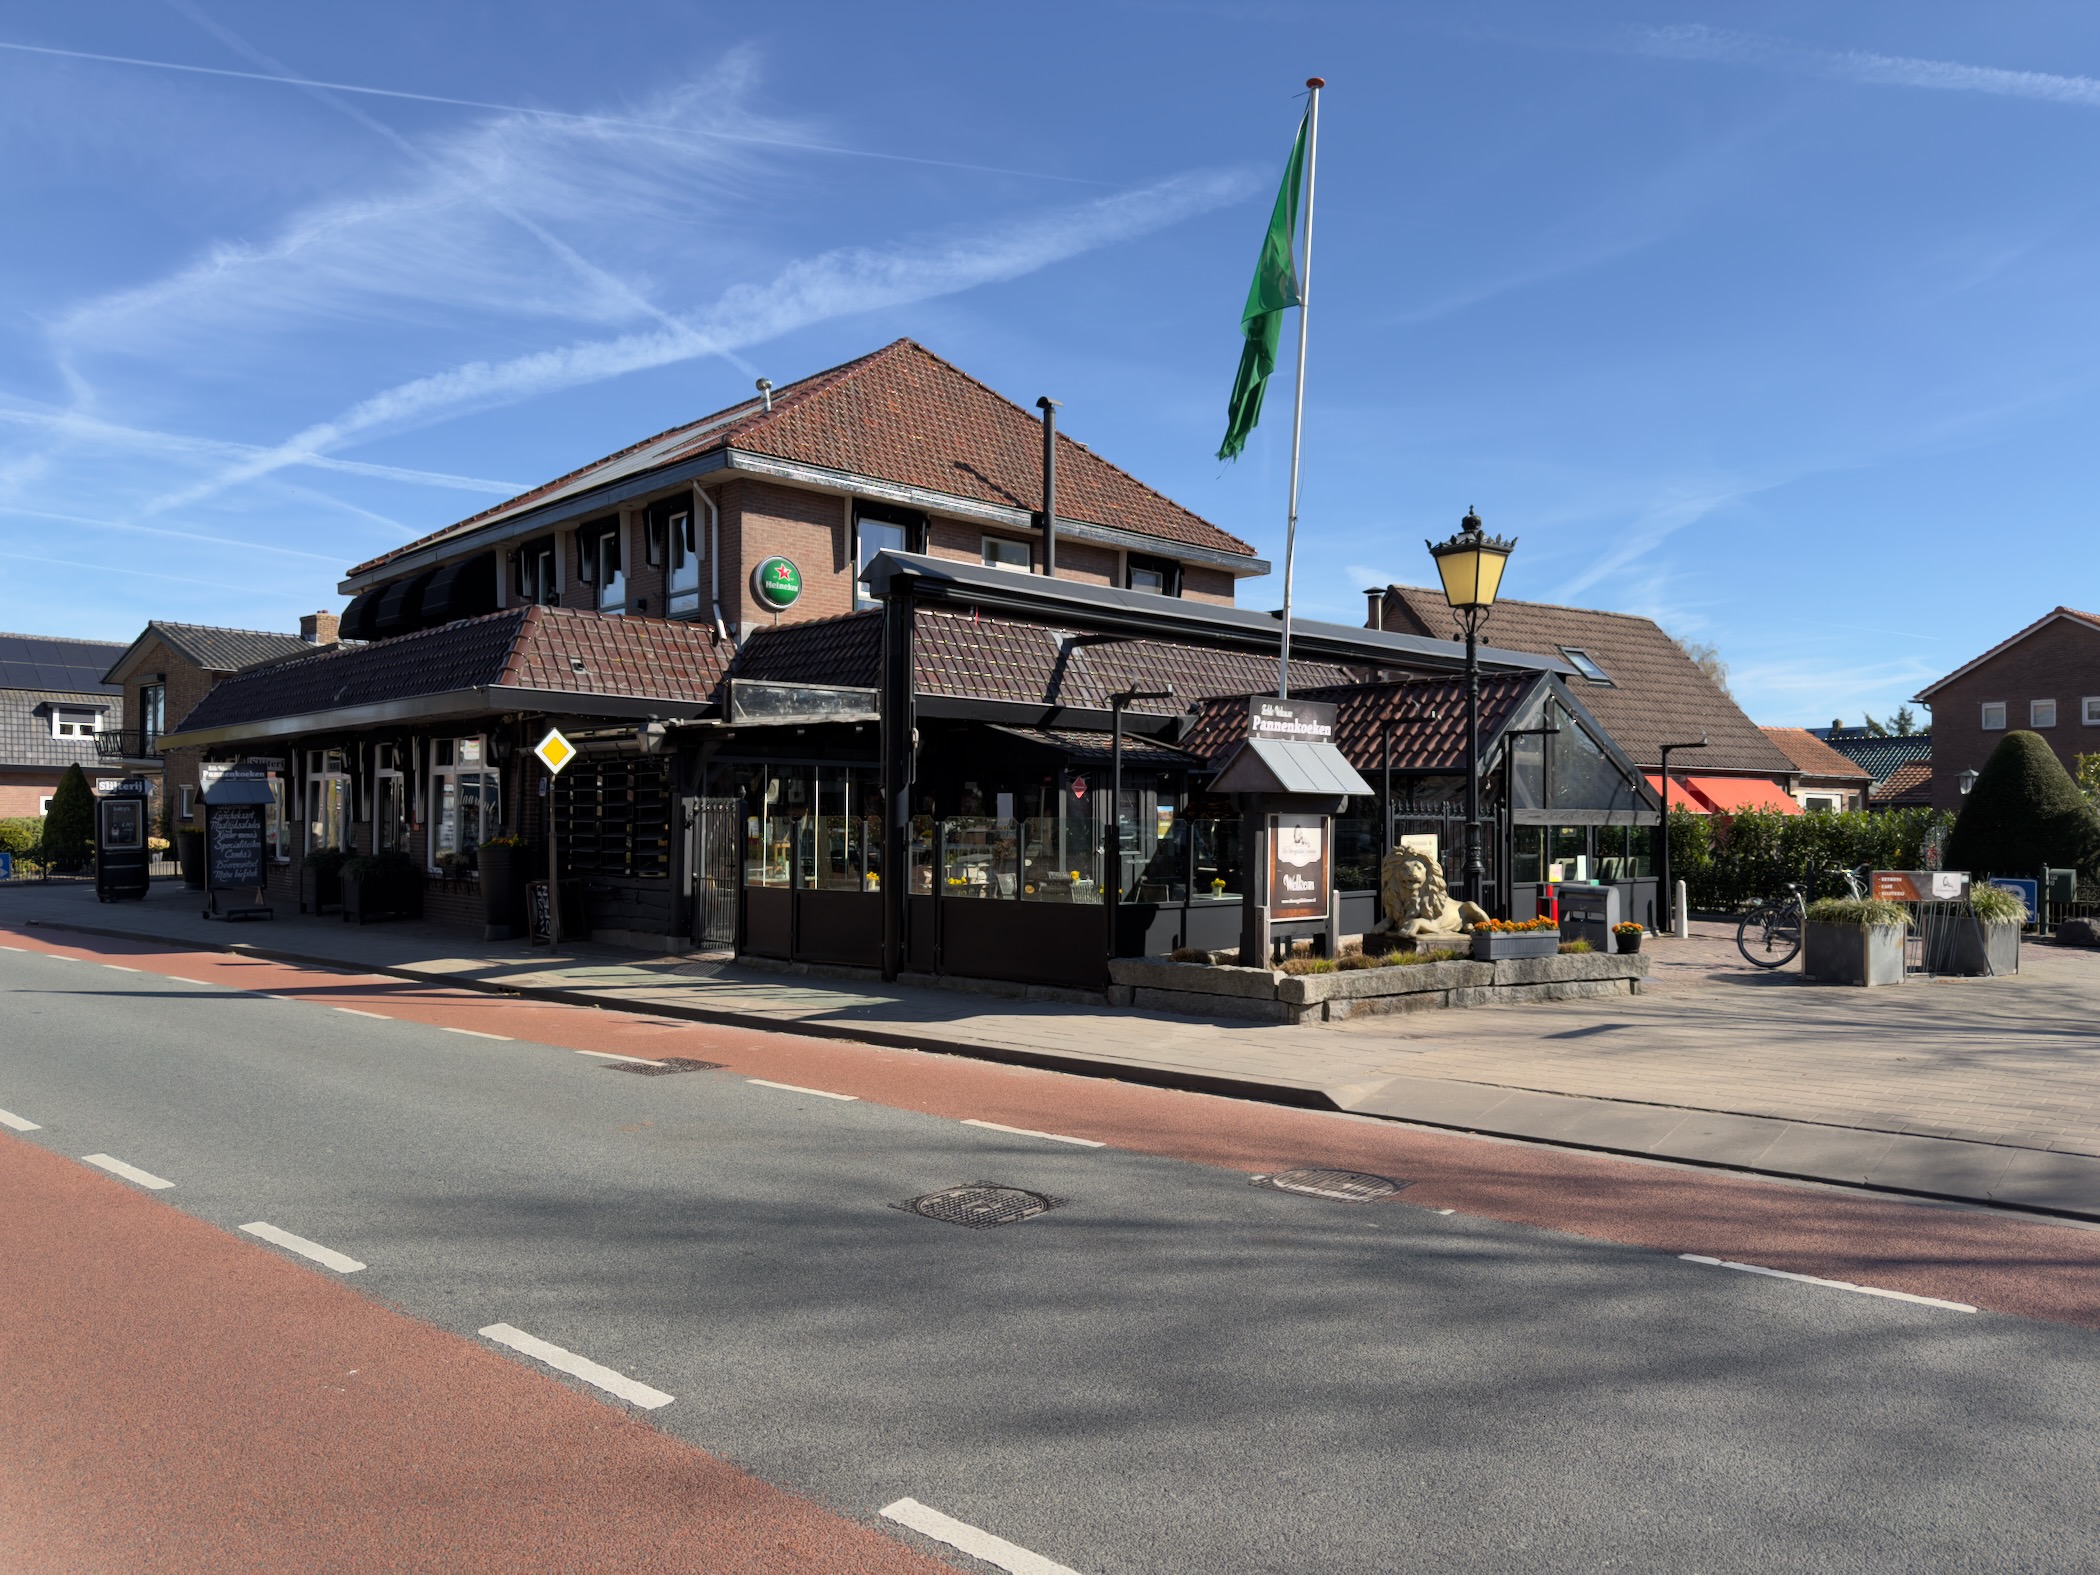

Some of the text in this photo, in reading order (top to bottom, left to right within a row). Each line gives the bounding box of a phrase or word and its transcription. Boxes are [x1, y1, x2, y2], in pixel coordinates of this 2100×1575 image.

[765, 580, 799, 592] Heineken
[1252, 715, 1332, 736] Pannenkoeken
[202, 770, 265, 778] Pannenkoeken
[99, 781, 142, 792] Slijterij
